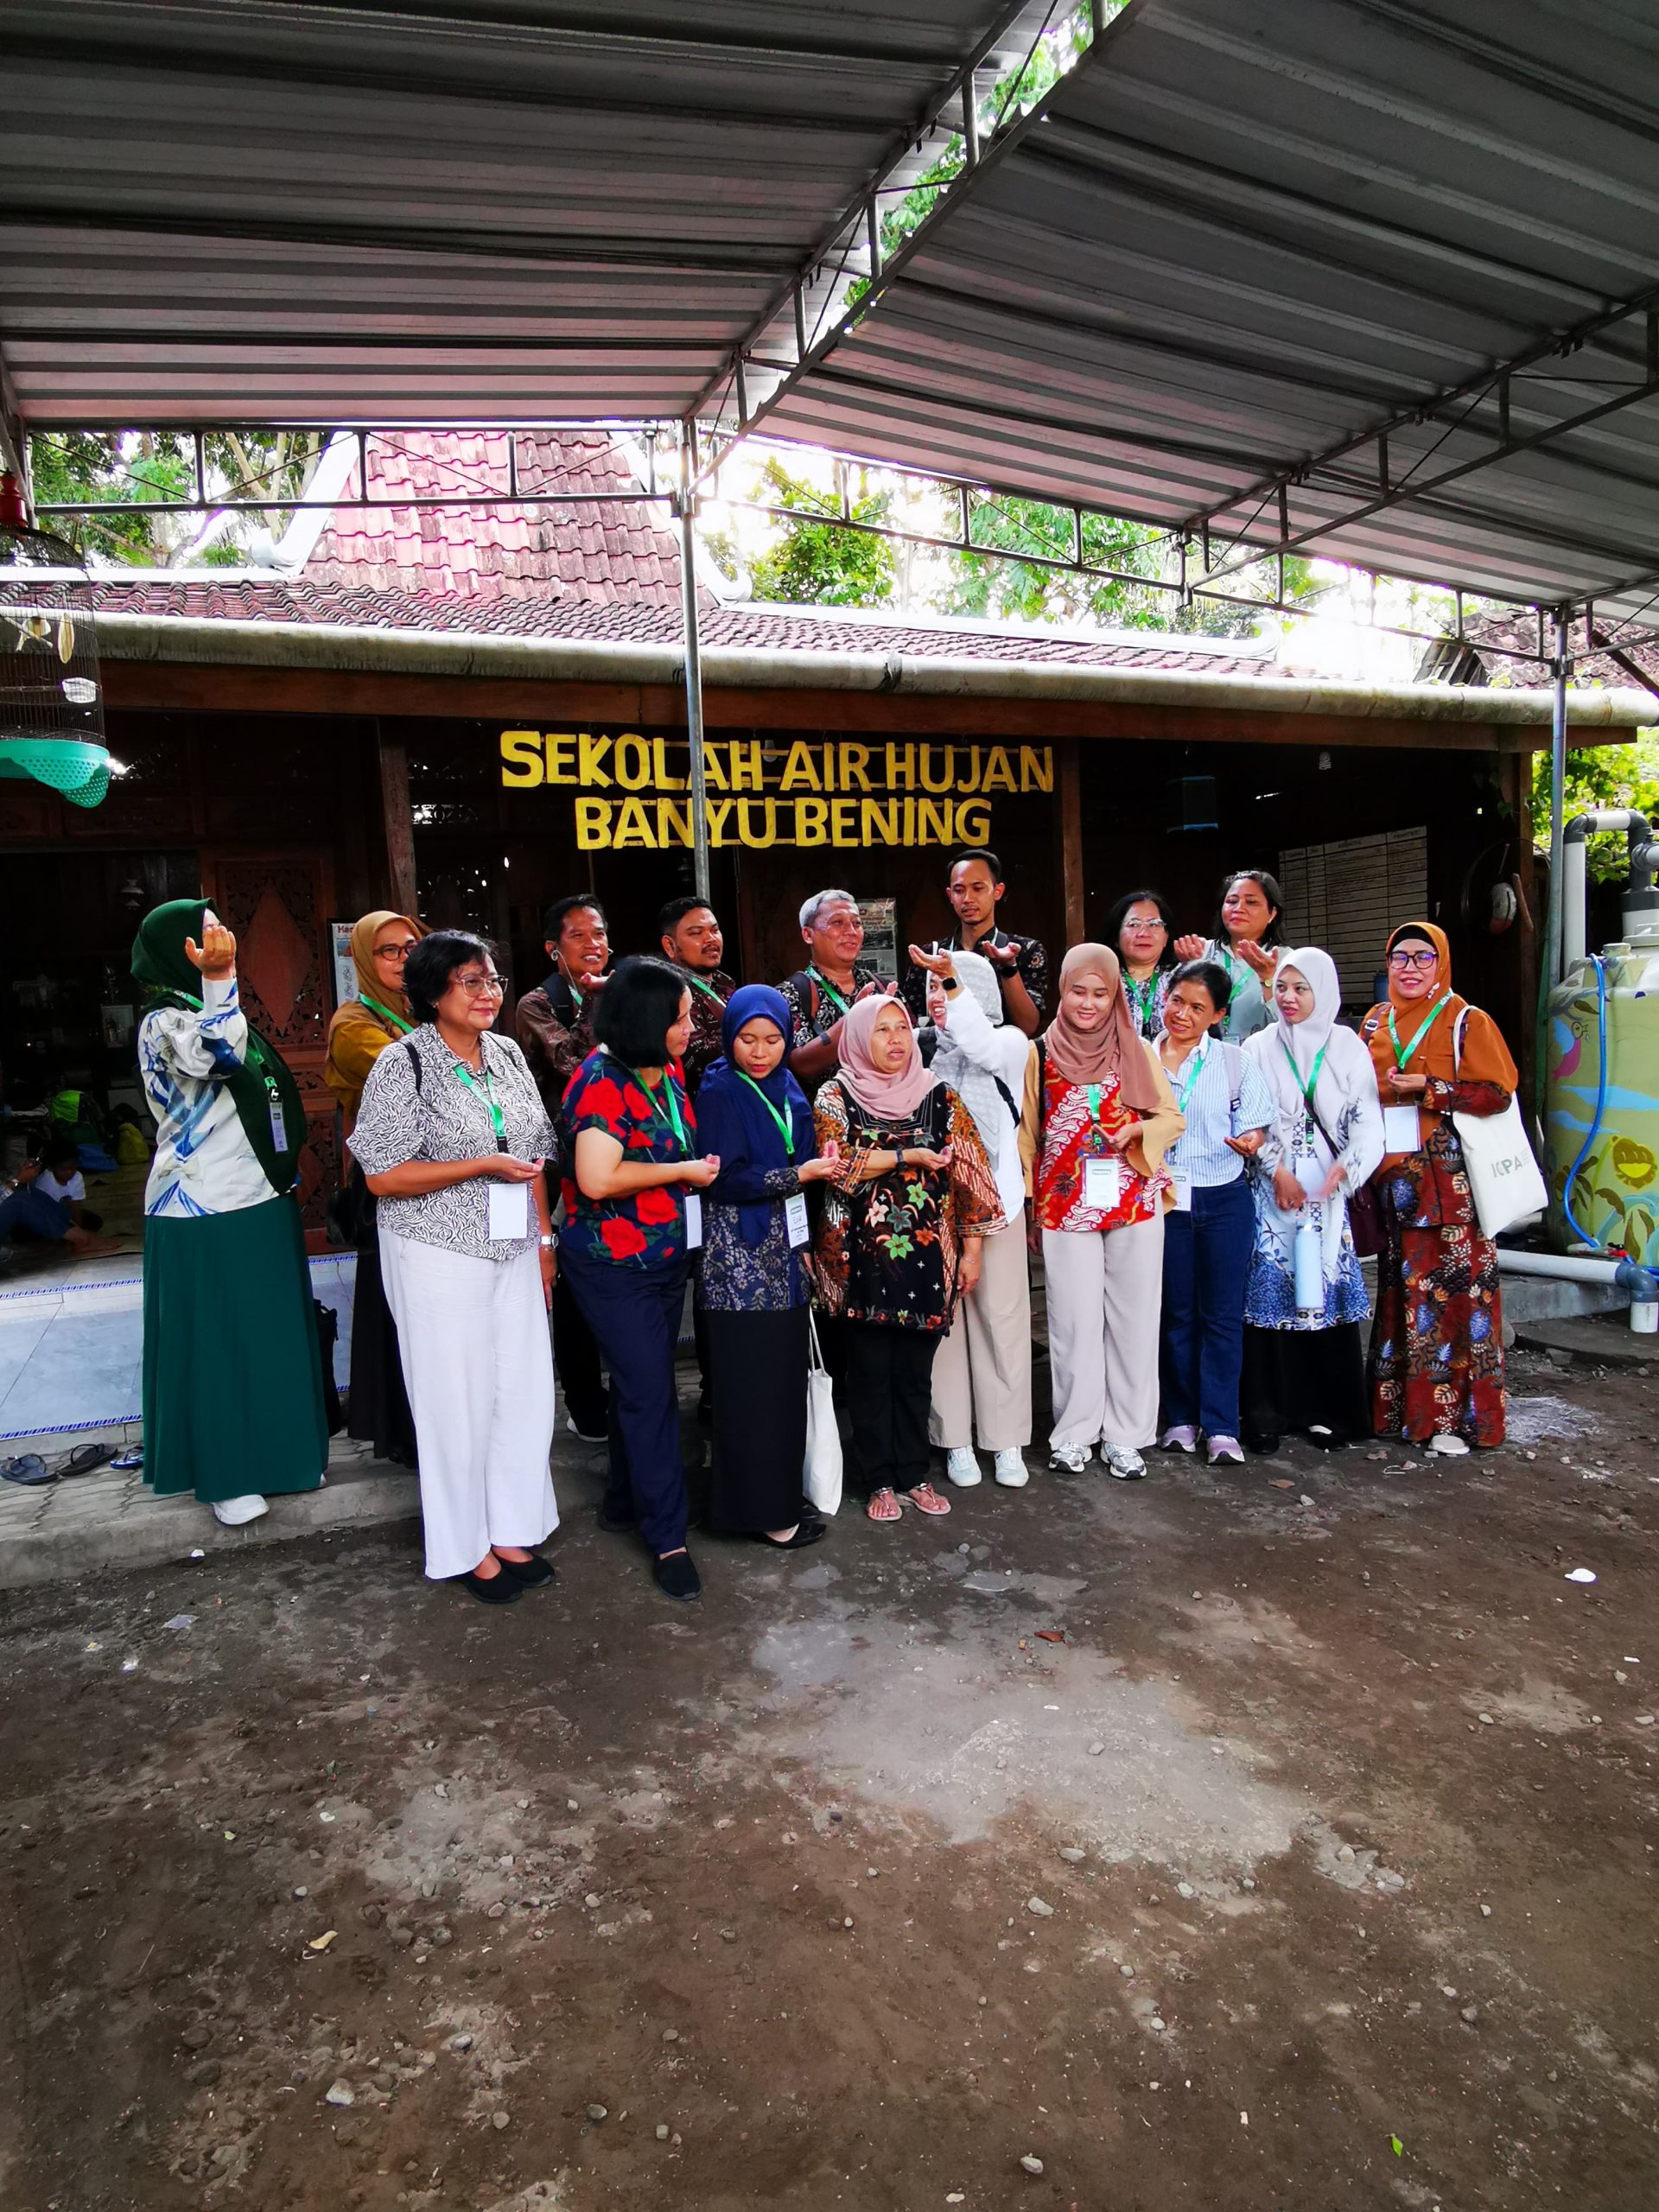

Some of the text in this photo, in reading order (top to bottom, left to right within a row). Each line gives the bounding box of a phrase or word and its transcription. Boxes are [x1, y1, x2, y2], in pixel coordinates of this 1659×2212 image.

[500, 730, 1053, 793] SEKOLAH AIR HUJAN
[575, 796, 992, 850] BANYU BENING
